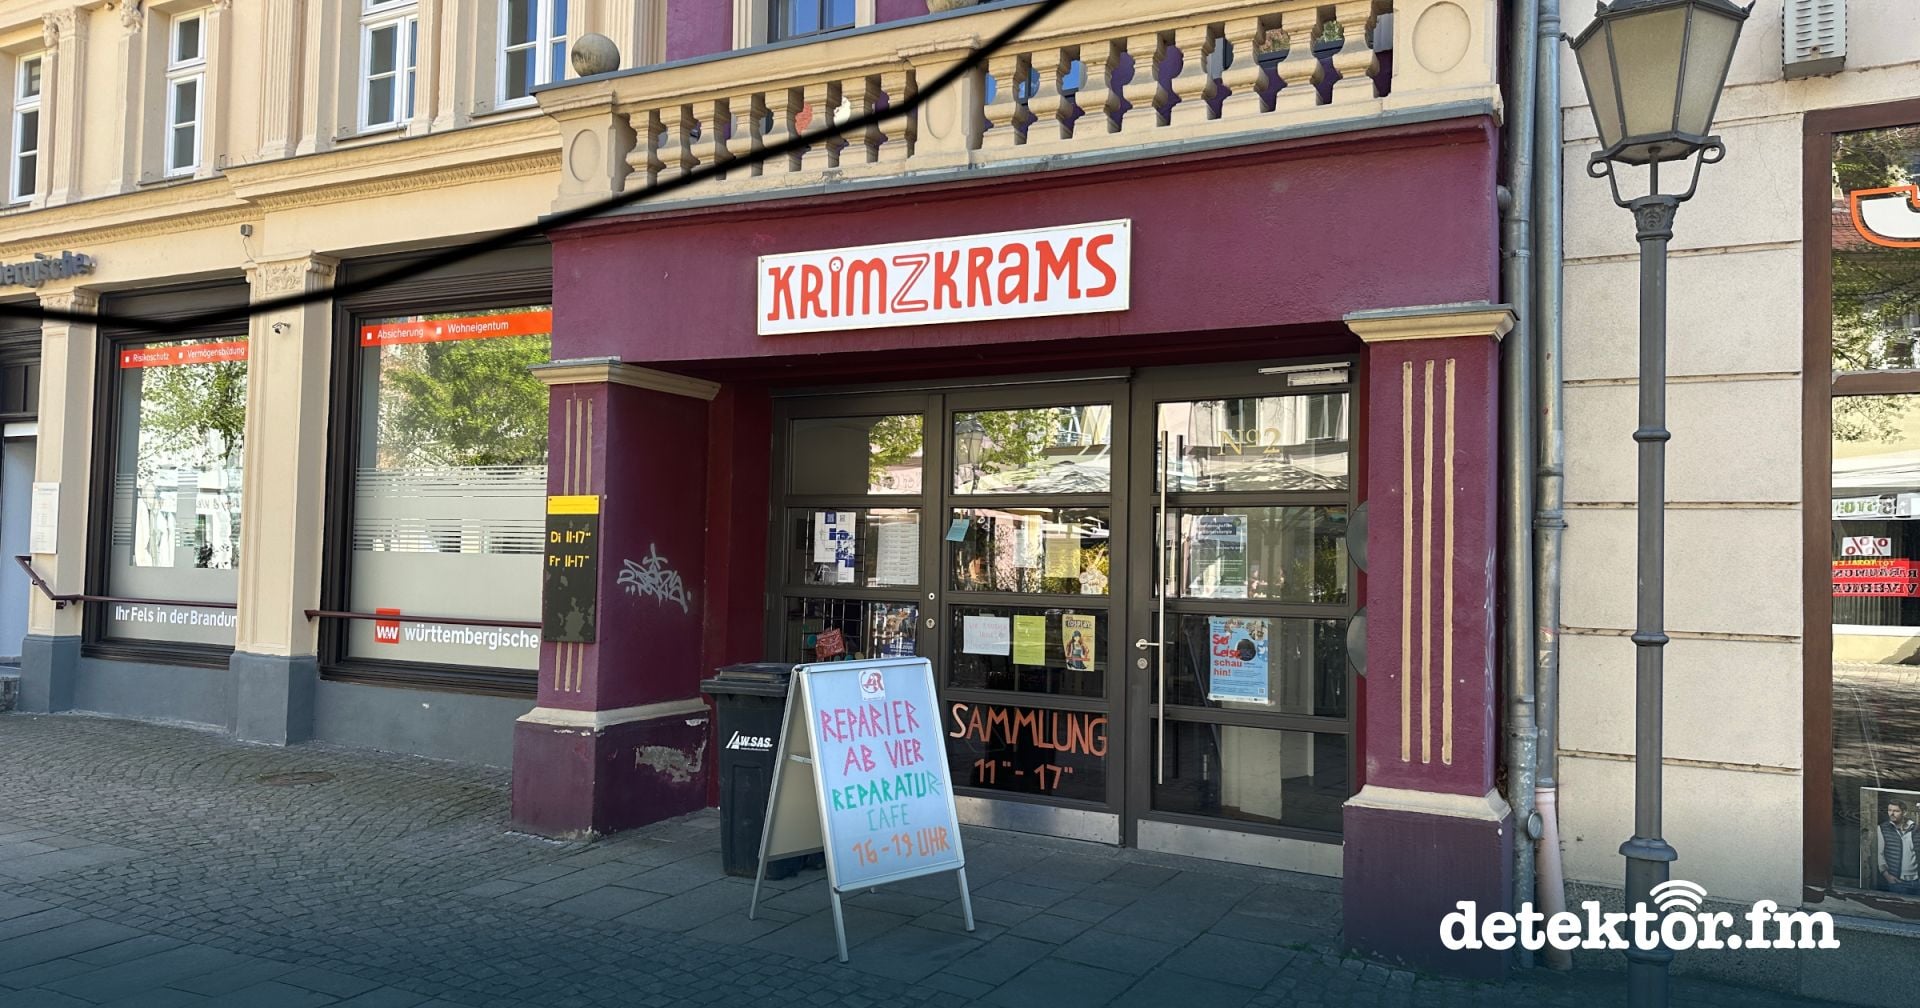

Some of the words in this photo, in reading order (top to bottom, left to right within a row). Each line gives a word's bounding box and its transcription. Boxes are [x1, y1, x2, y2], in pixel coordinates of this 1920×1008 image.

[377, 327, 424, 341] Absicherung
[447, 320, 509, 334] Wohneigentum
[132, 352, 170, 362] Risikoschutz
[187, 346, 245, 360] Vermögensbildung
[550, 530, 561, 543] Di
[549, 555, 560, 567] Fr
[115, 606, 130, 621] Ihr
[131, 607, 154, 623] Fels
[157, 608, 167, 623] in
[169, 609, 189, 625] der
[404, 624, 539, 650] württembergische
[1214, 659, 1242, 668] schau
[1214, 668, 1232, 676] hin!
[820, 700, 920, 743] REPARIER
[950, 703, 1108, 757] SAMMLUNG
[843, 744, 876, 776] AB
[884, 738, 924, 769] VIER
[852, 838, 879, 867] 16
[917, 826, 950, 857] UHR
